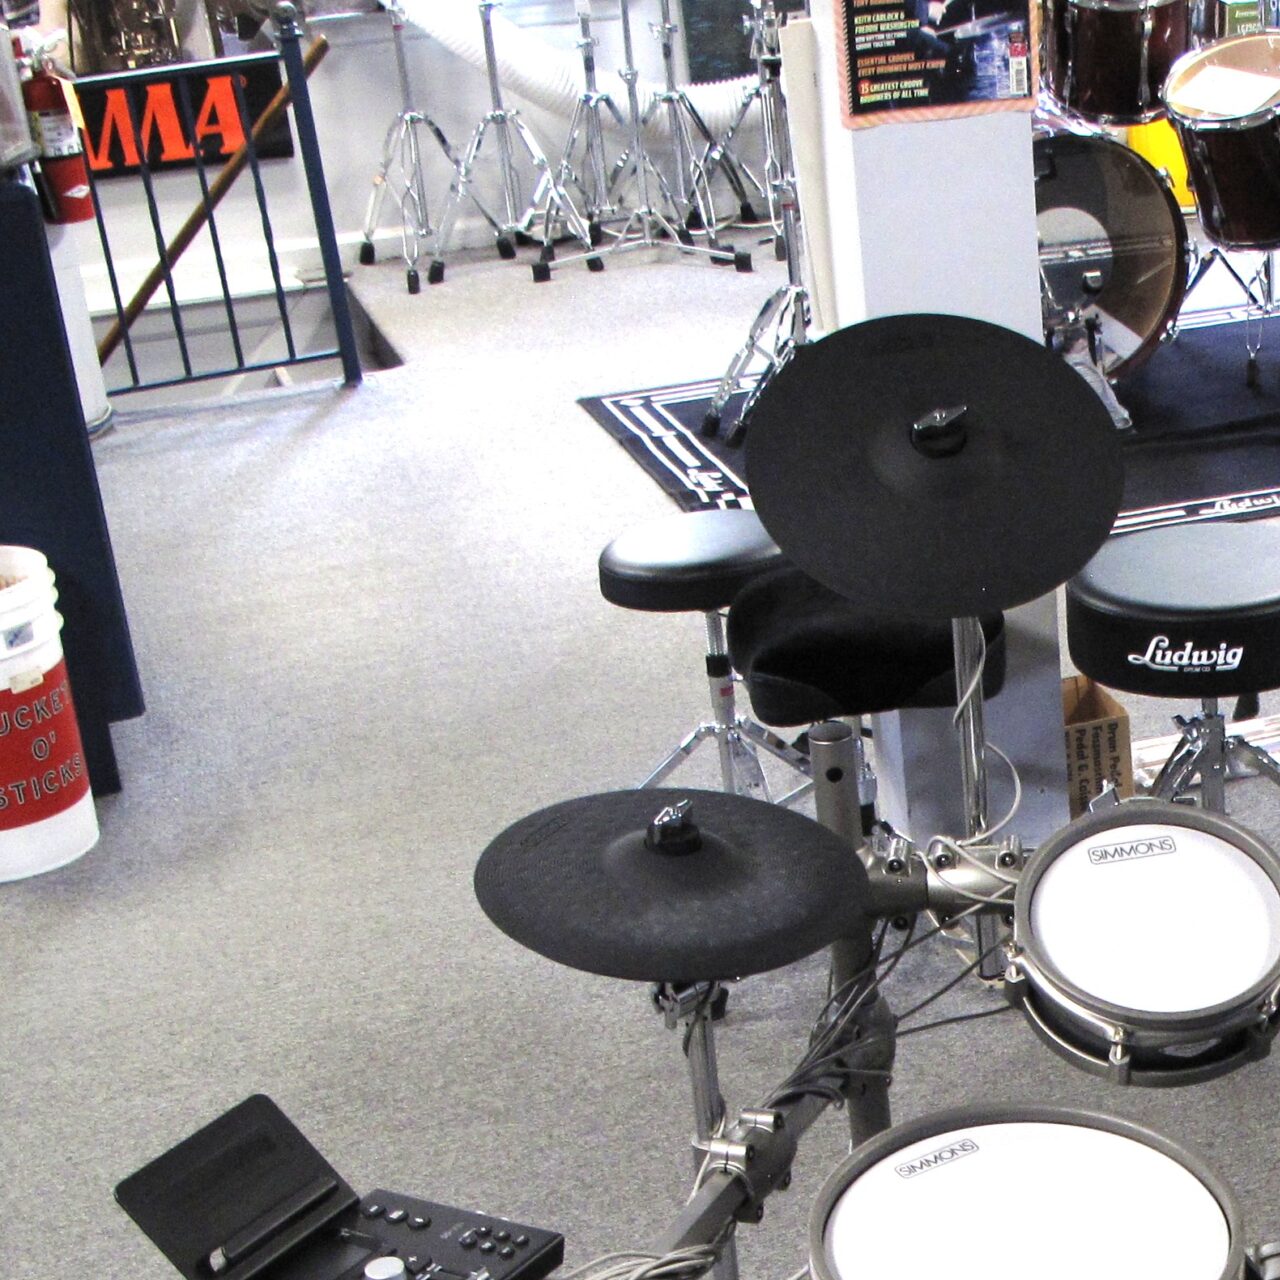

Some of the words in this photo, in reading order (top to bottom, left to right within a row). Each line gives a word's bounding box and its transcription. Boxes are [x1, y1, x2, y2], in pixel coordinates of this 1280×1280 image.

[861, 83, 869, 94] 15
[870, 81, 899, 93] GREATEST
[892, 90, 901, 99] OF
[901, 89, 913, 98] ALL
[1127, 635, 1244, 672] Ludwig
[1092, 839, 1173, 862] SIMMONS
[900, 1141, 975, 1177] SIMMONS
